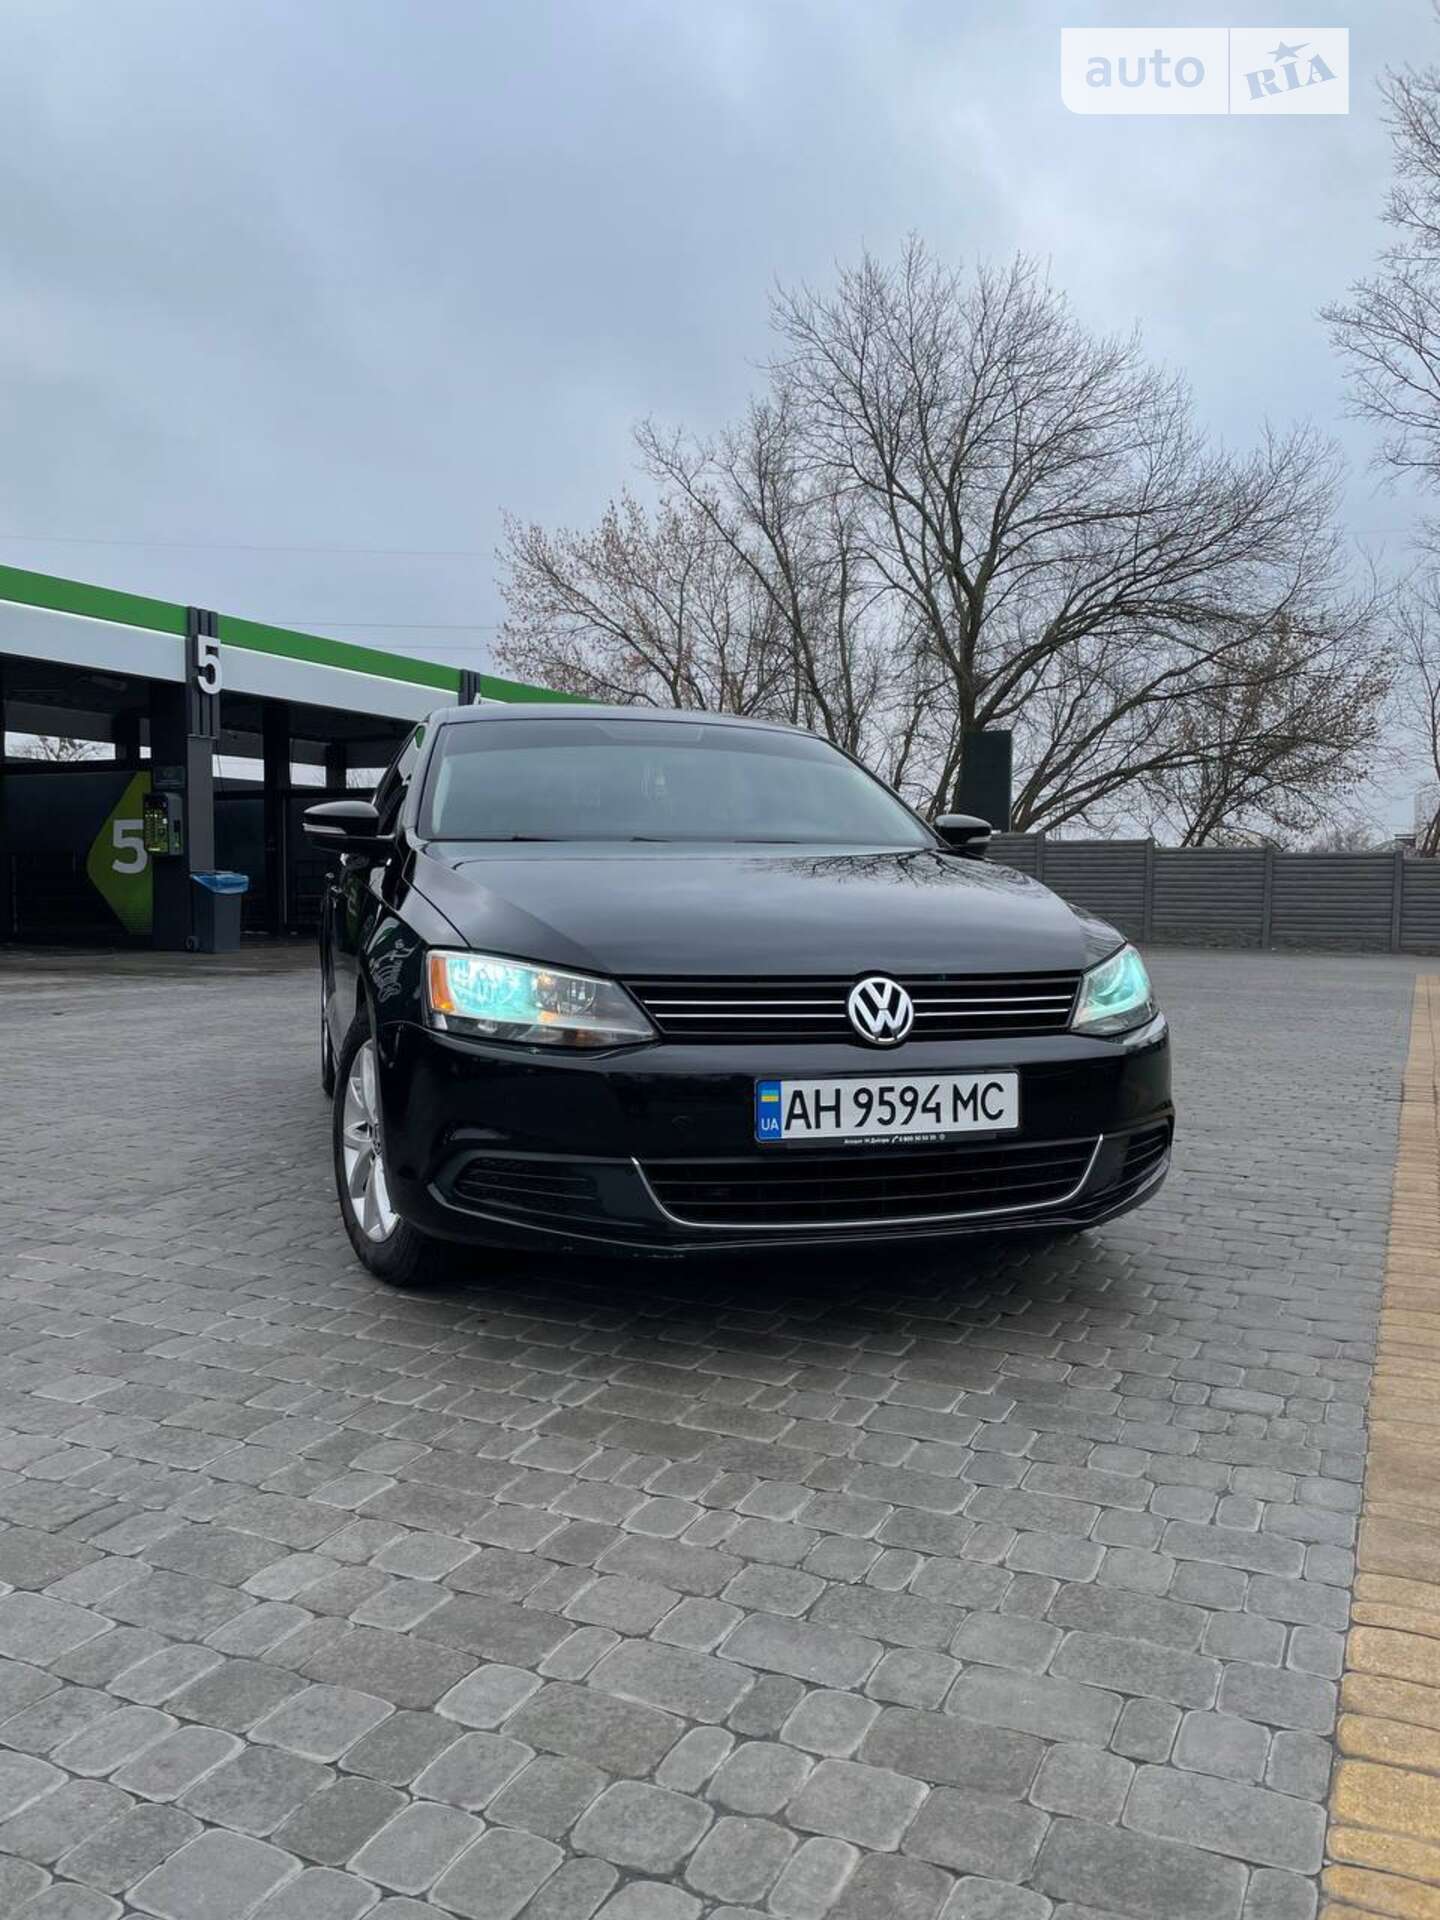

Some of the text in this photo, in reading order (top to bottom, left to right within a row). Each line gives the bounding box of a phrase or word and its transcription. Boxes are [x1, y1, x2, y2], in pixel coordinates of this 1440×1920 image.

[198, 634, 222, 694] 5
[112, 819, 147, 874] 5
[761, 1118, 779, 1131] UA
[784, 1082, 1004, 1130] AH 9594 MC
